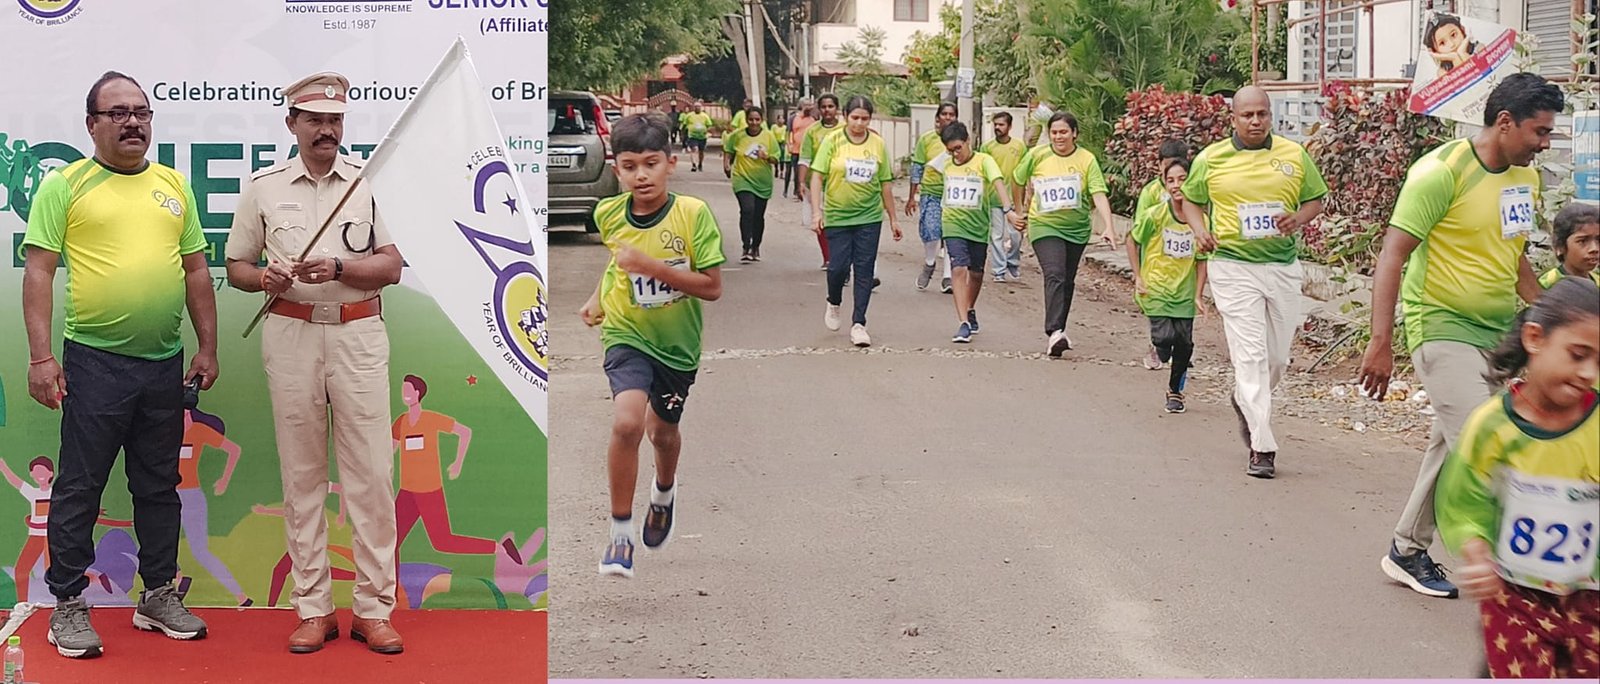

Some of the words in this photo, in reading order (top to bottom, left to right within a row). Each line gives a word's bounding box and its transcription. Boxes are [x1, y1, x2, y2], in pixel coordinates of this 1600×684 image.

[18, 9, 35, 22] YEAR
[46, 6, 83, 26] BRILLIANCE
[285, 5, 350, 13] KNOWLEDGE
[364, 4, 412, 12] SUPREME
[152, 81, 285, 106] Celebrating
[348, 81, 419, 101] orious
[491, 80, 516, 100] of
[505, 136, 544, 154] king
[470, 146, 504, 165] CELEB
[947, 185, 977, 201] 1817
[1041, 186, 1075, 203] 1820
[635, 276, 680, 296] 114
[482, 302, 497, 333] YEAR
[492, 335, 506, 351] OF
[502, 351, 548, 393] BRILLIAN
